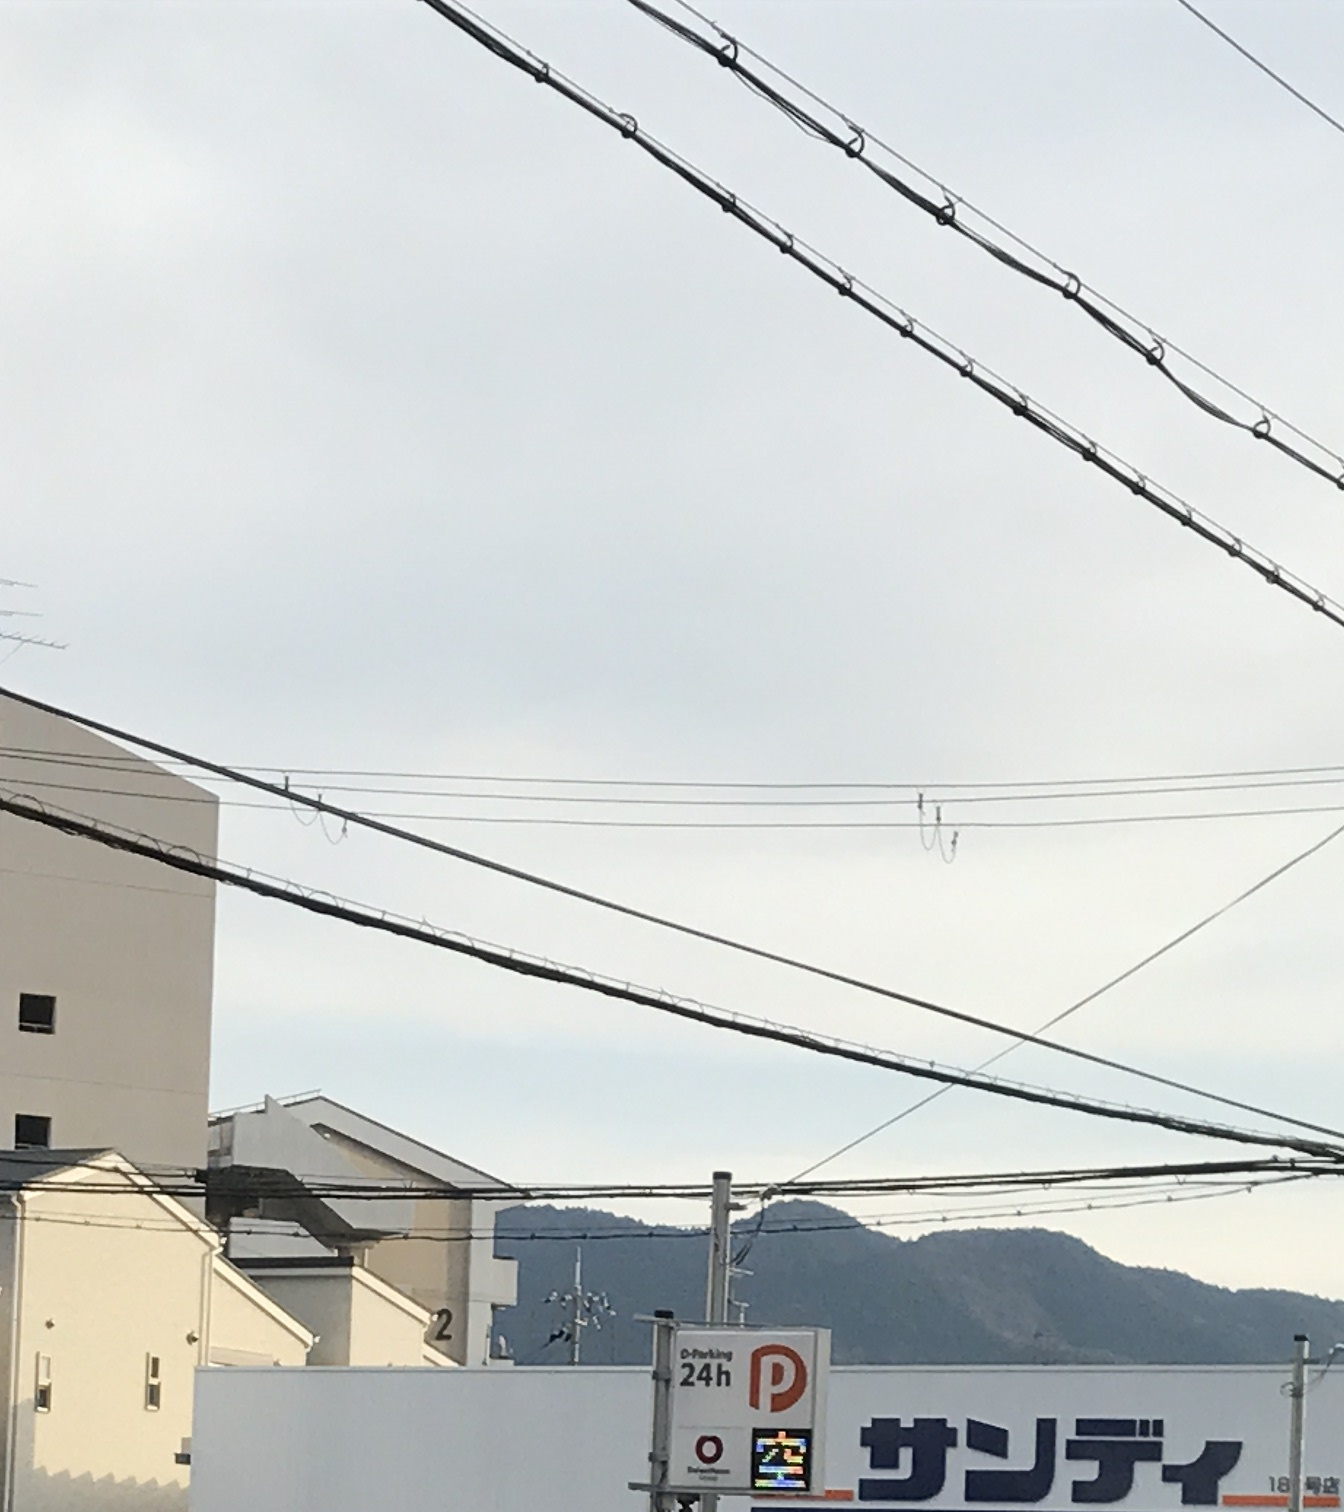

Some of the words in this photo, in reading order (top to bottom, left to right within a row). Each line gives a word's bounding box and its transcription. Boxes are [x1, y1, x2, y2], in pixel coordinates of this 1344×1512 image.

[680, 1348, 733, 1362] D-Parking
[679, 1362, 731, 1387] 24h
[858, 1417, 1243, 1506] サンディ
[1268, 1476, 1341, 1496] 18号店
